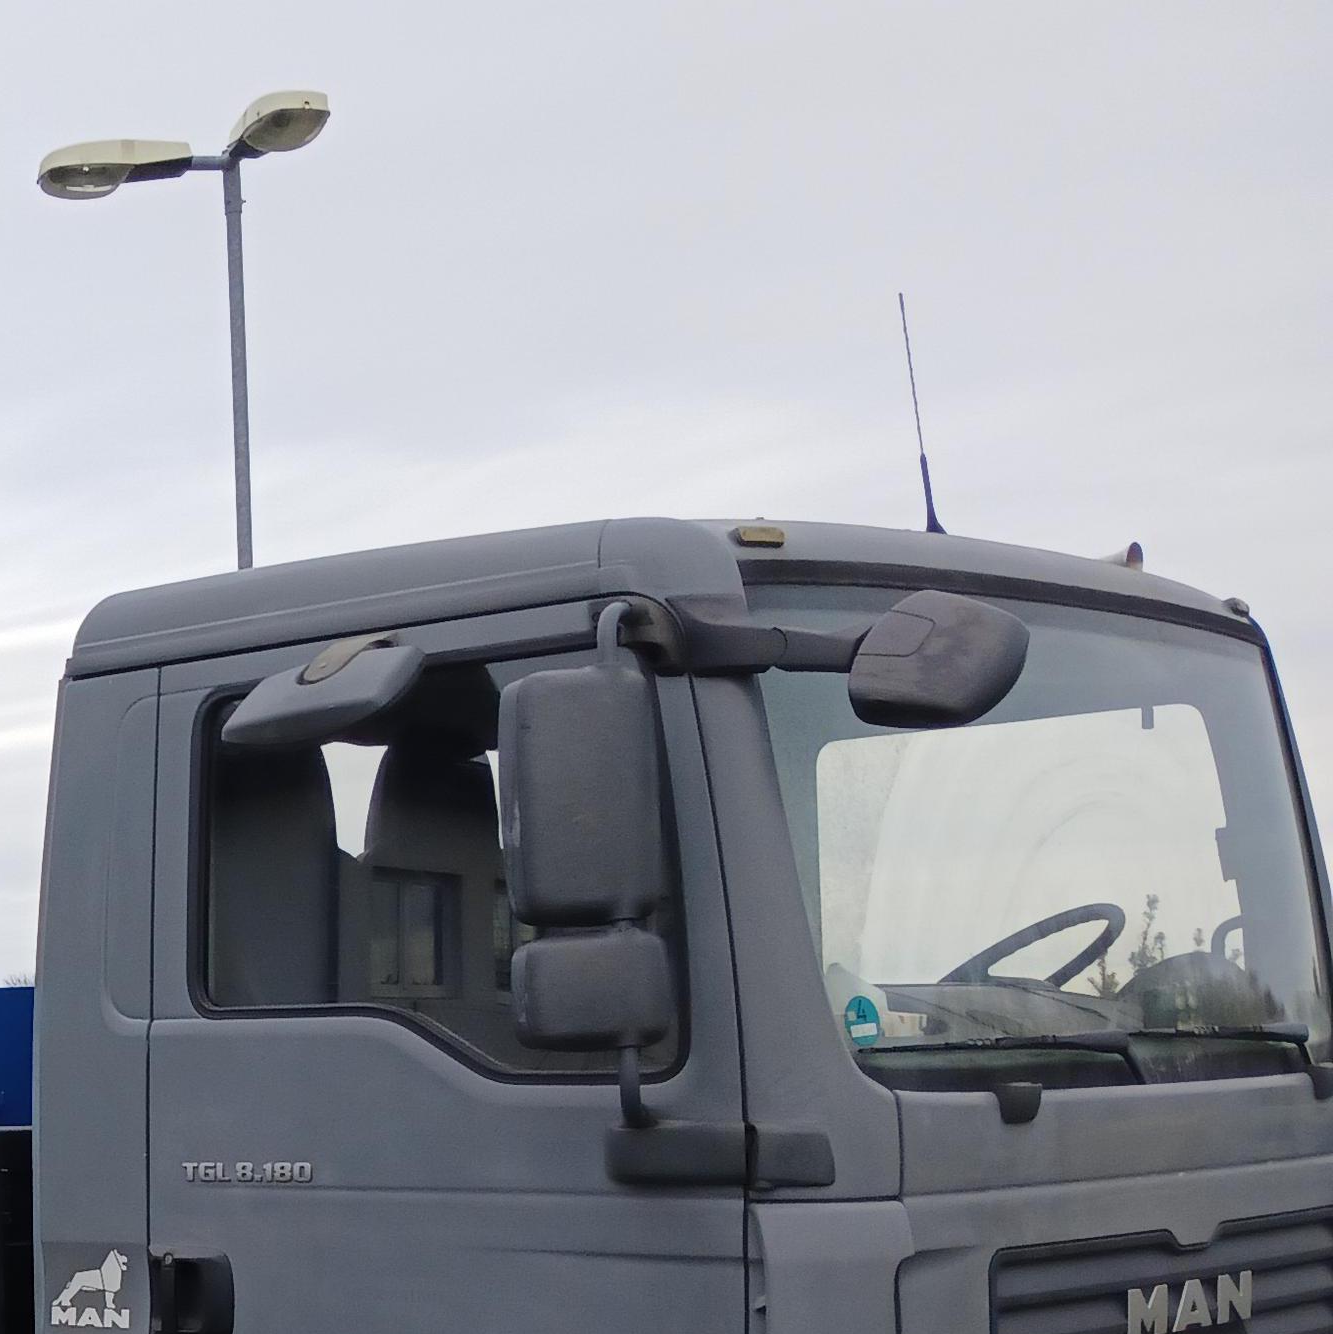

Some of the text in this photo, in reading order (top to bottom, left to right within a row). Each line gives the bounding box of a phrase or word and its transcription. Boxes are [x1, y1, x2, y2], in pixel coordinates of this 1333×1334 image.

[856, 999, 867, 1023] 4
[181, 1161, 315, 1184] TGL 8.180
[51, 1306, 130, 1329] MAN
